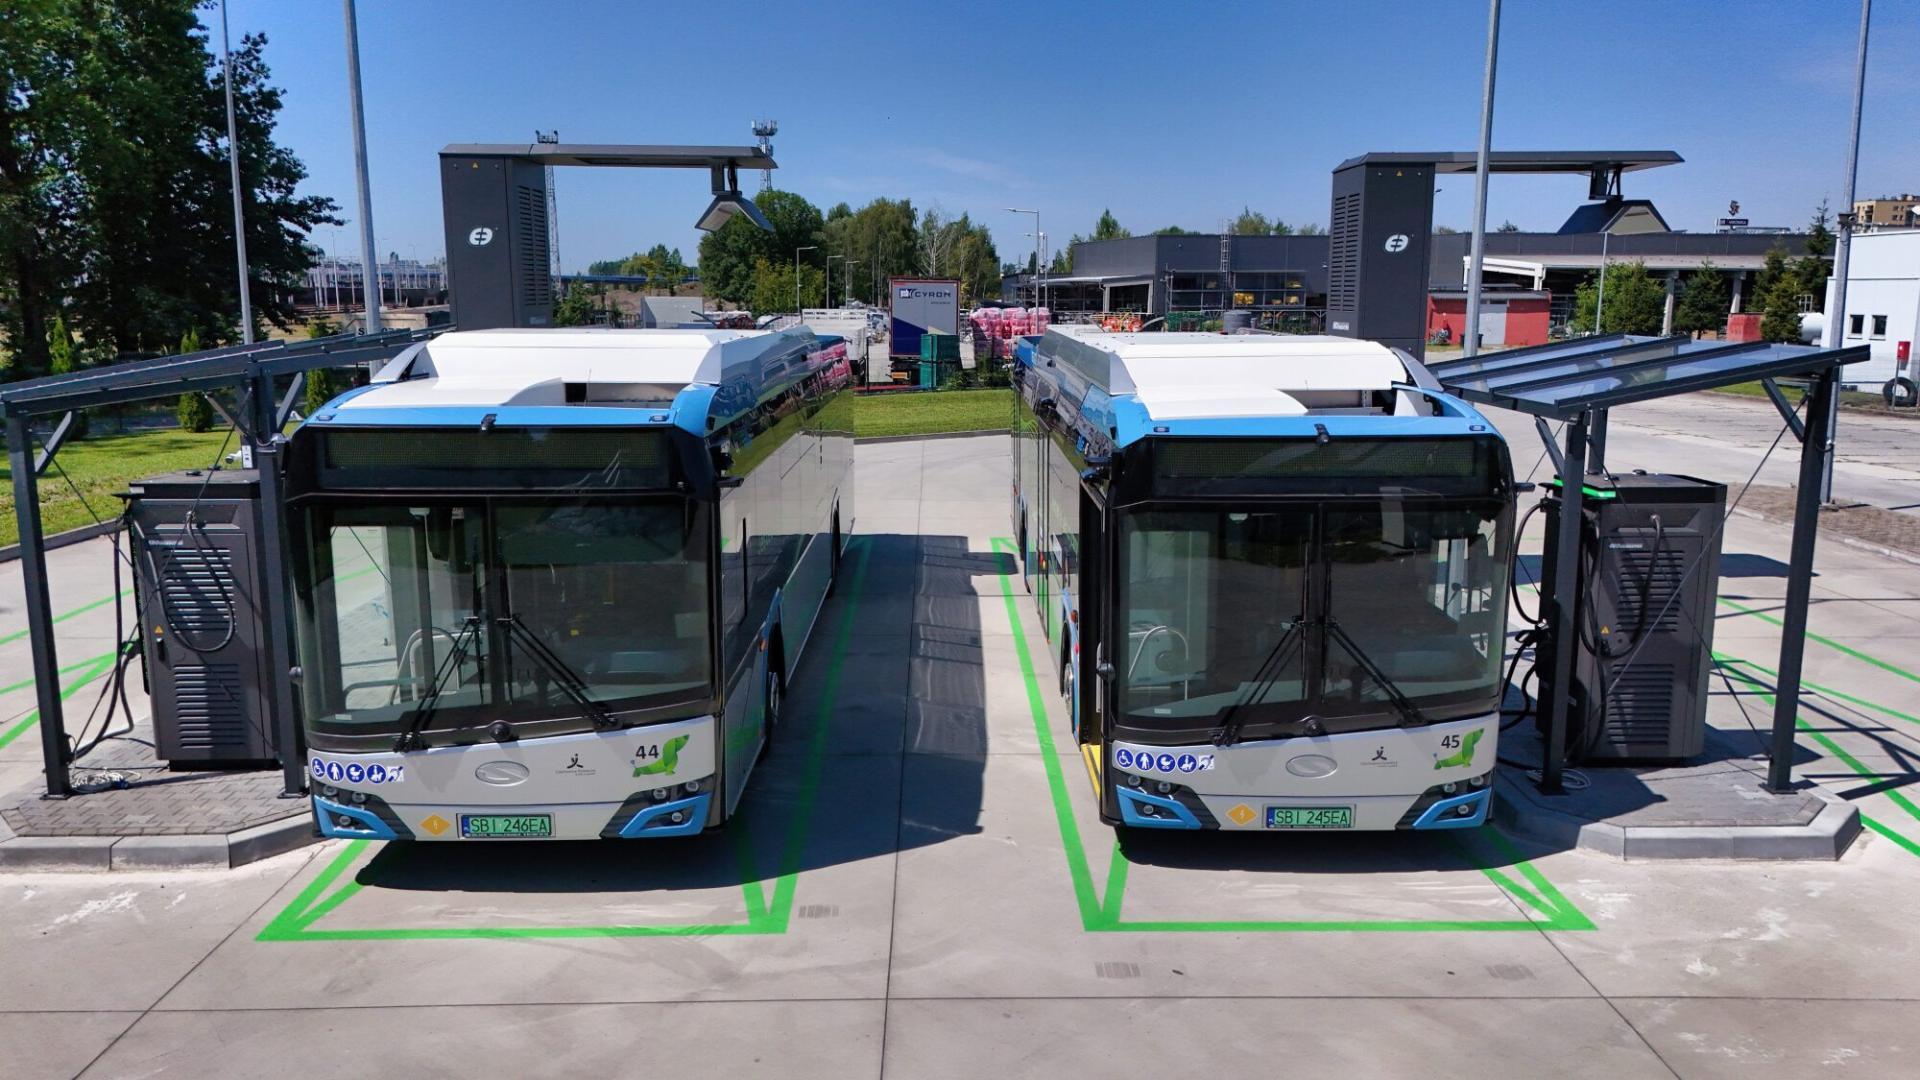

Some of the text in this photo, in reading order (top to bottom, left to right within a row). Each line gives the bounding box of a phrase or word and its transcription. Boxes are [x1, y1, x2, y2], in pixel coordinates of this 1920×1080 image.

[1441, 734, 1460, 749] 45
[635, 744, 659, 760] 44
[1276, 810, 1348, 825] SBI 245EA
[470, 818, 548, 833] SBI 246EA
